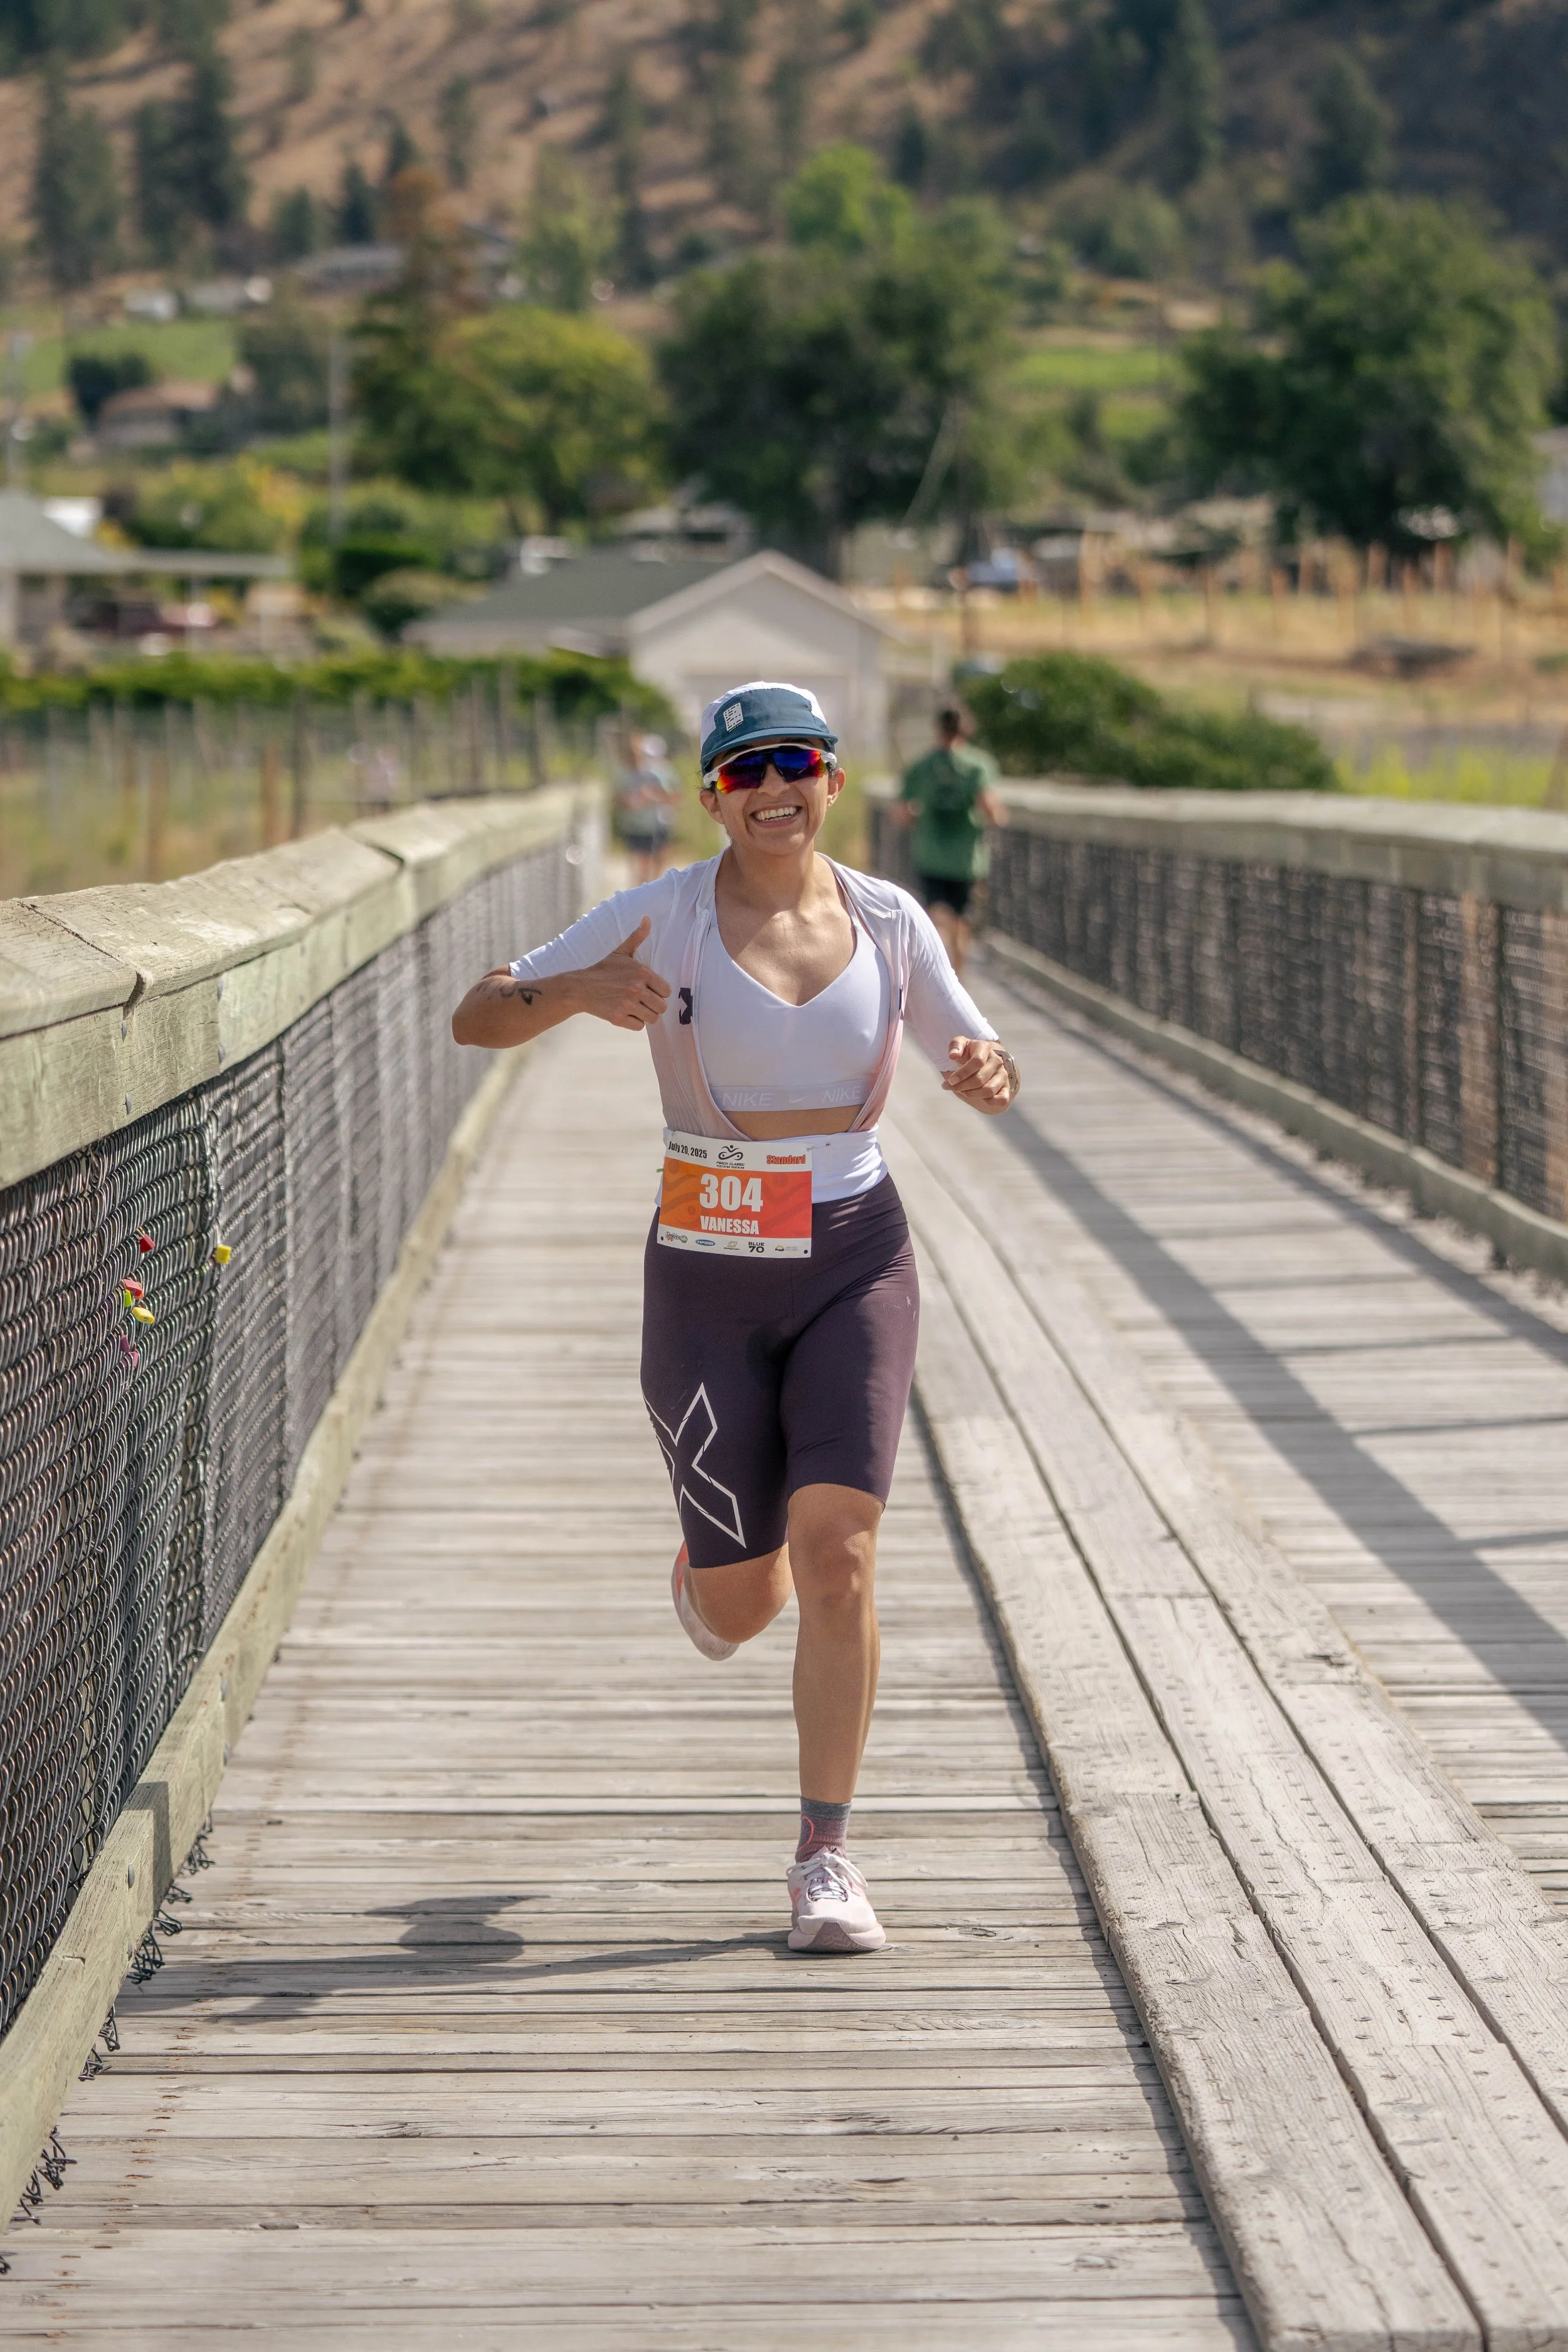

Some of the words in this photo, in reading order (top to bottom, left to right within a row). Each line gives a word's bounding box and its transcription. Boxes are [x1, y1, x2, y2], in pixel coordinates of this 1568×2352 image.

[721, 1092, 775, 1107] NIKE
[821, 1085, 862, 1104] NIKE
[668, 1140, 681, 1153] July
[681, 1145, 689, 1157] 20,
[691, 1147, 707, 1159] 2025
[766, 1155, 806, 1165] Standard
[699, 1173, 763, 1212] 304
[700, 1215, 760, 1235] VANESSA
